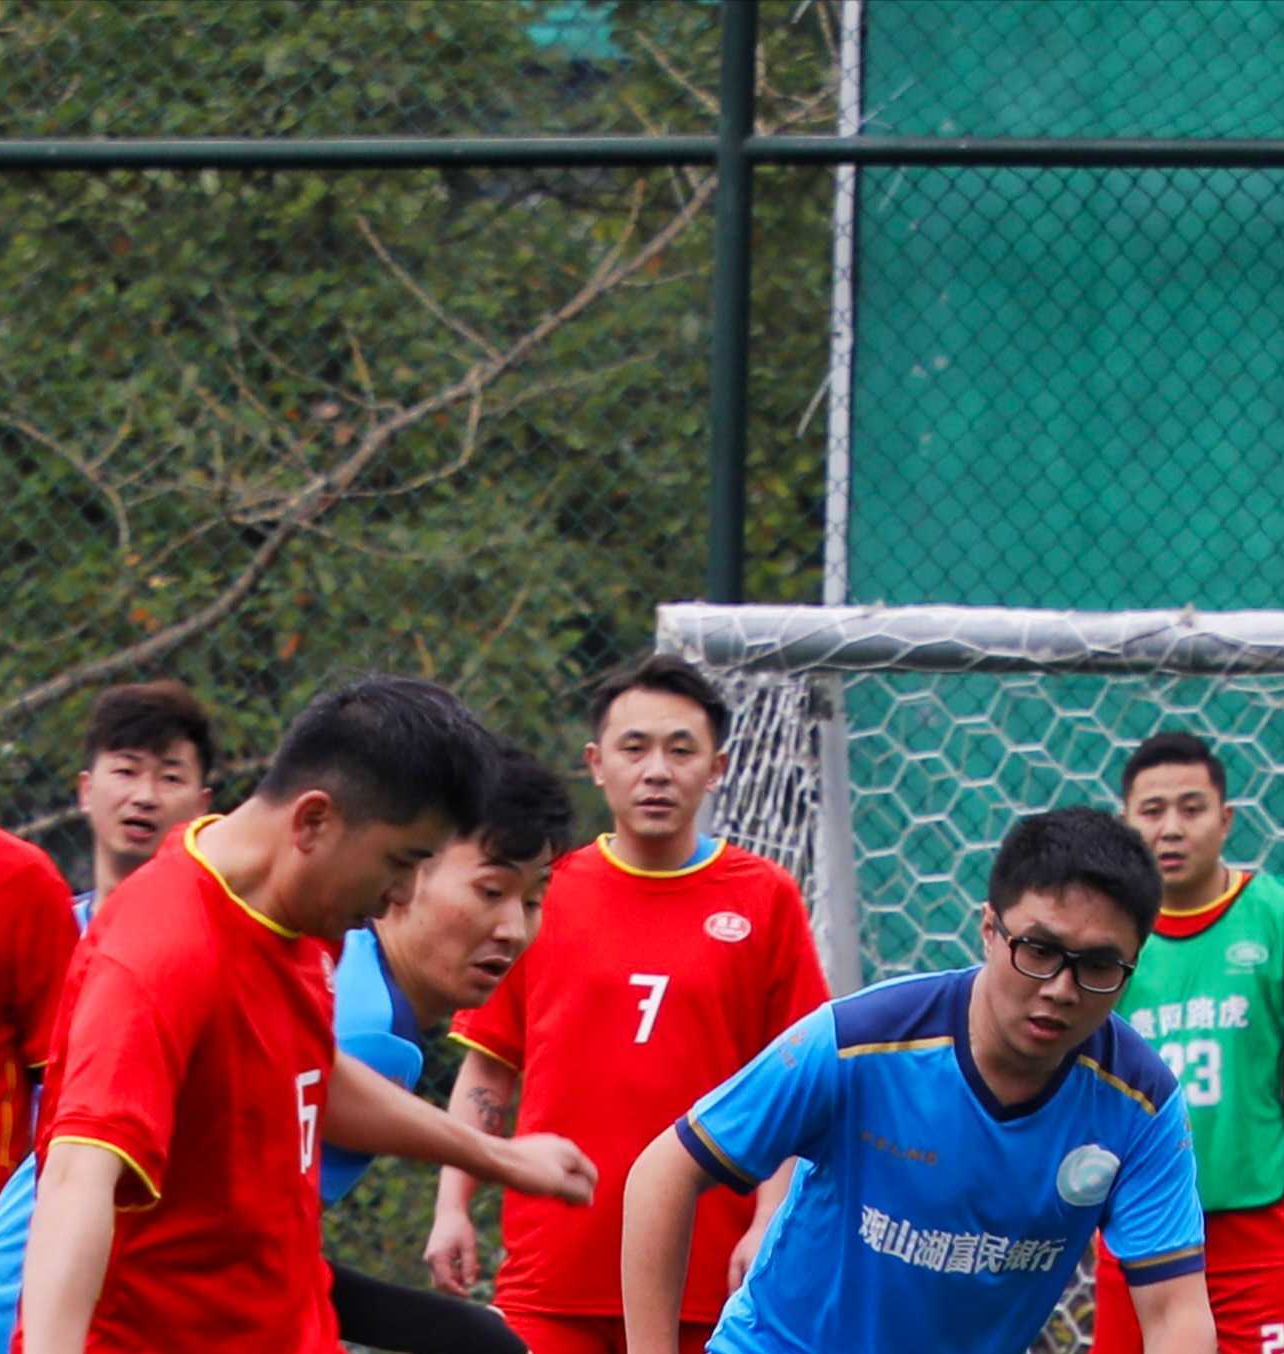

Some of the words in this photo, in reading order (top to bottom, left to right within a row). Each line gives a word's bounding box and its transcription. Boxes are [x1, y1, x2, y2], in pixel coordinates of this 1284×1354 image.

[628, 973, 671, 1044] 7
[858, 1203, 1067, 1276] 观山湖富民银行
